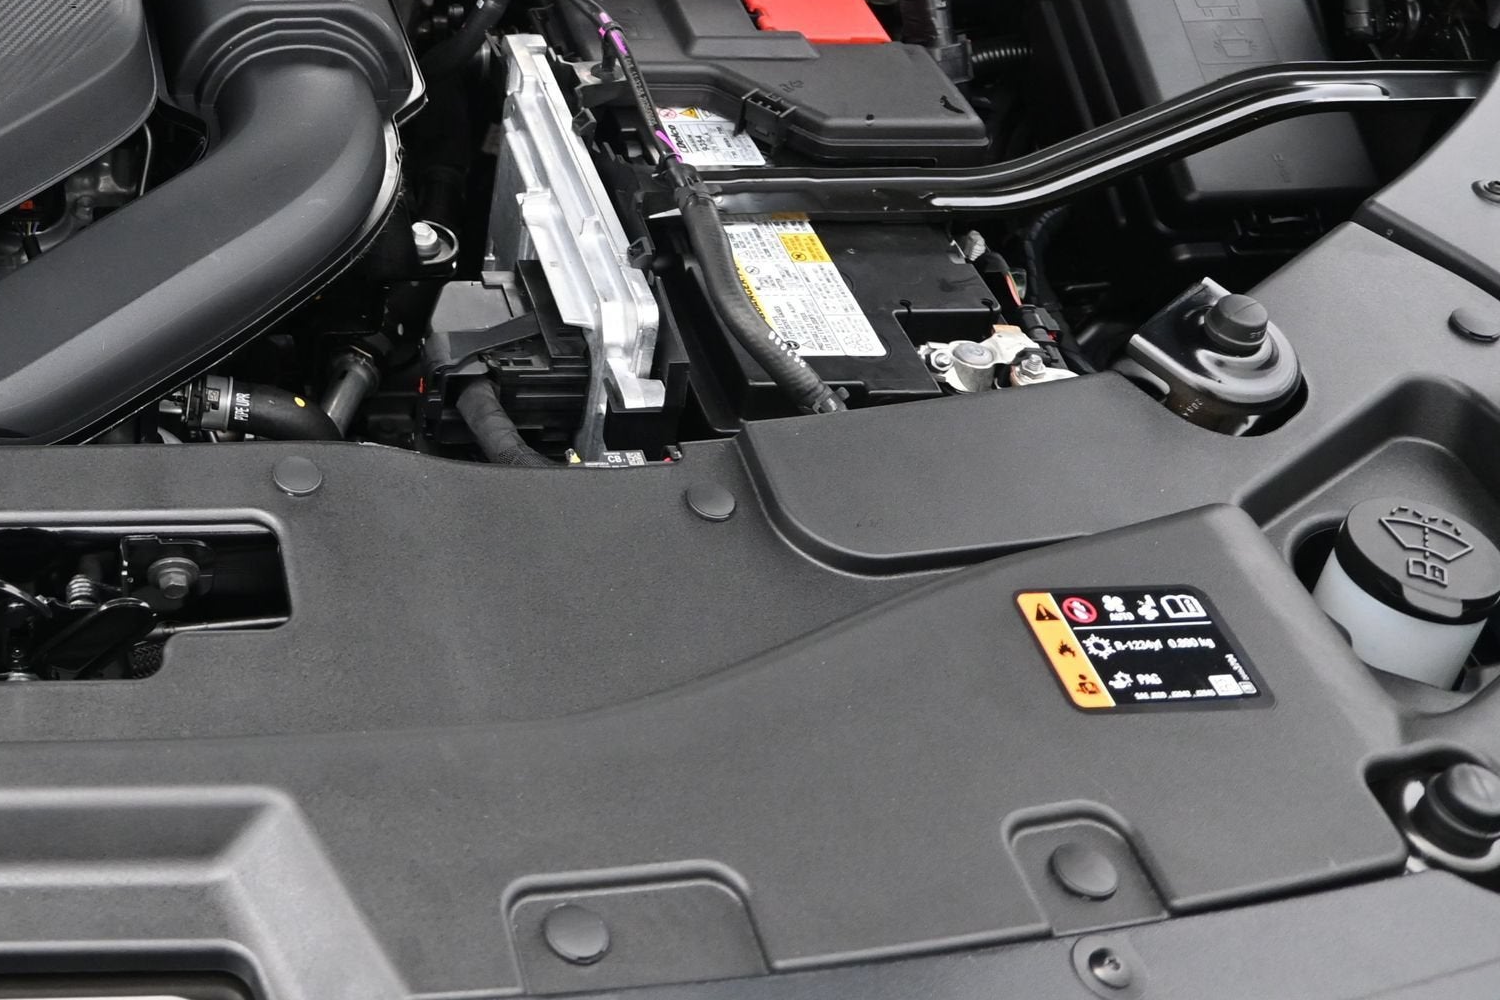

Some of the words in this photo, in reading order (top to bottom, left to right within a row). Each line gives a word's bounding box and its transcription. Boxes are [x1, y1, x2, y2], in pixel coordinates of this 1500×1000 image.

[235, 392, 251, 406] UPR
[234, 407, 250, 421] PIPE
[607, 455, 622, 463] CB
